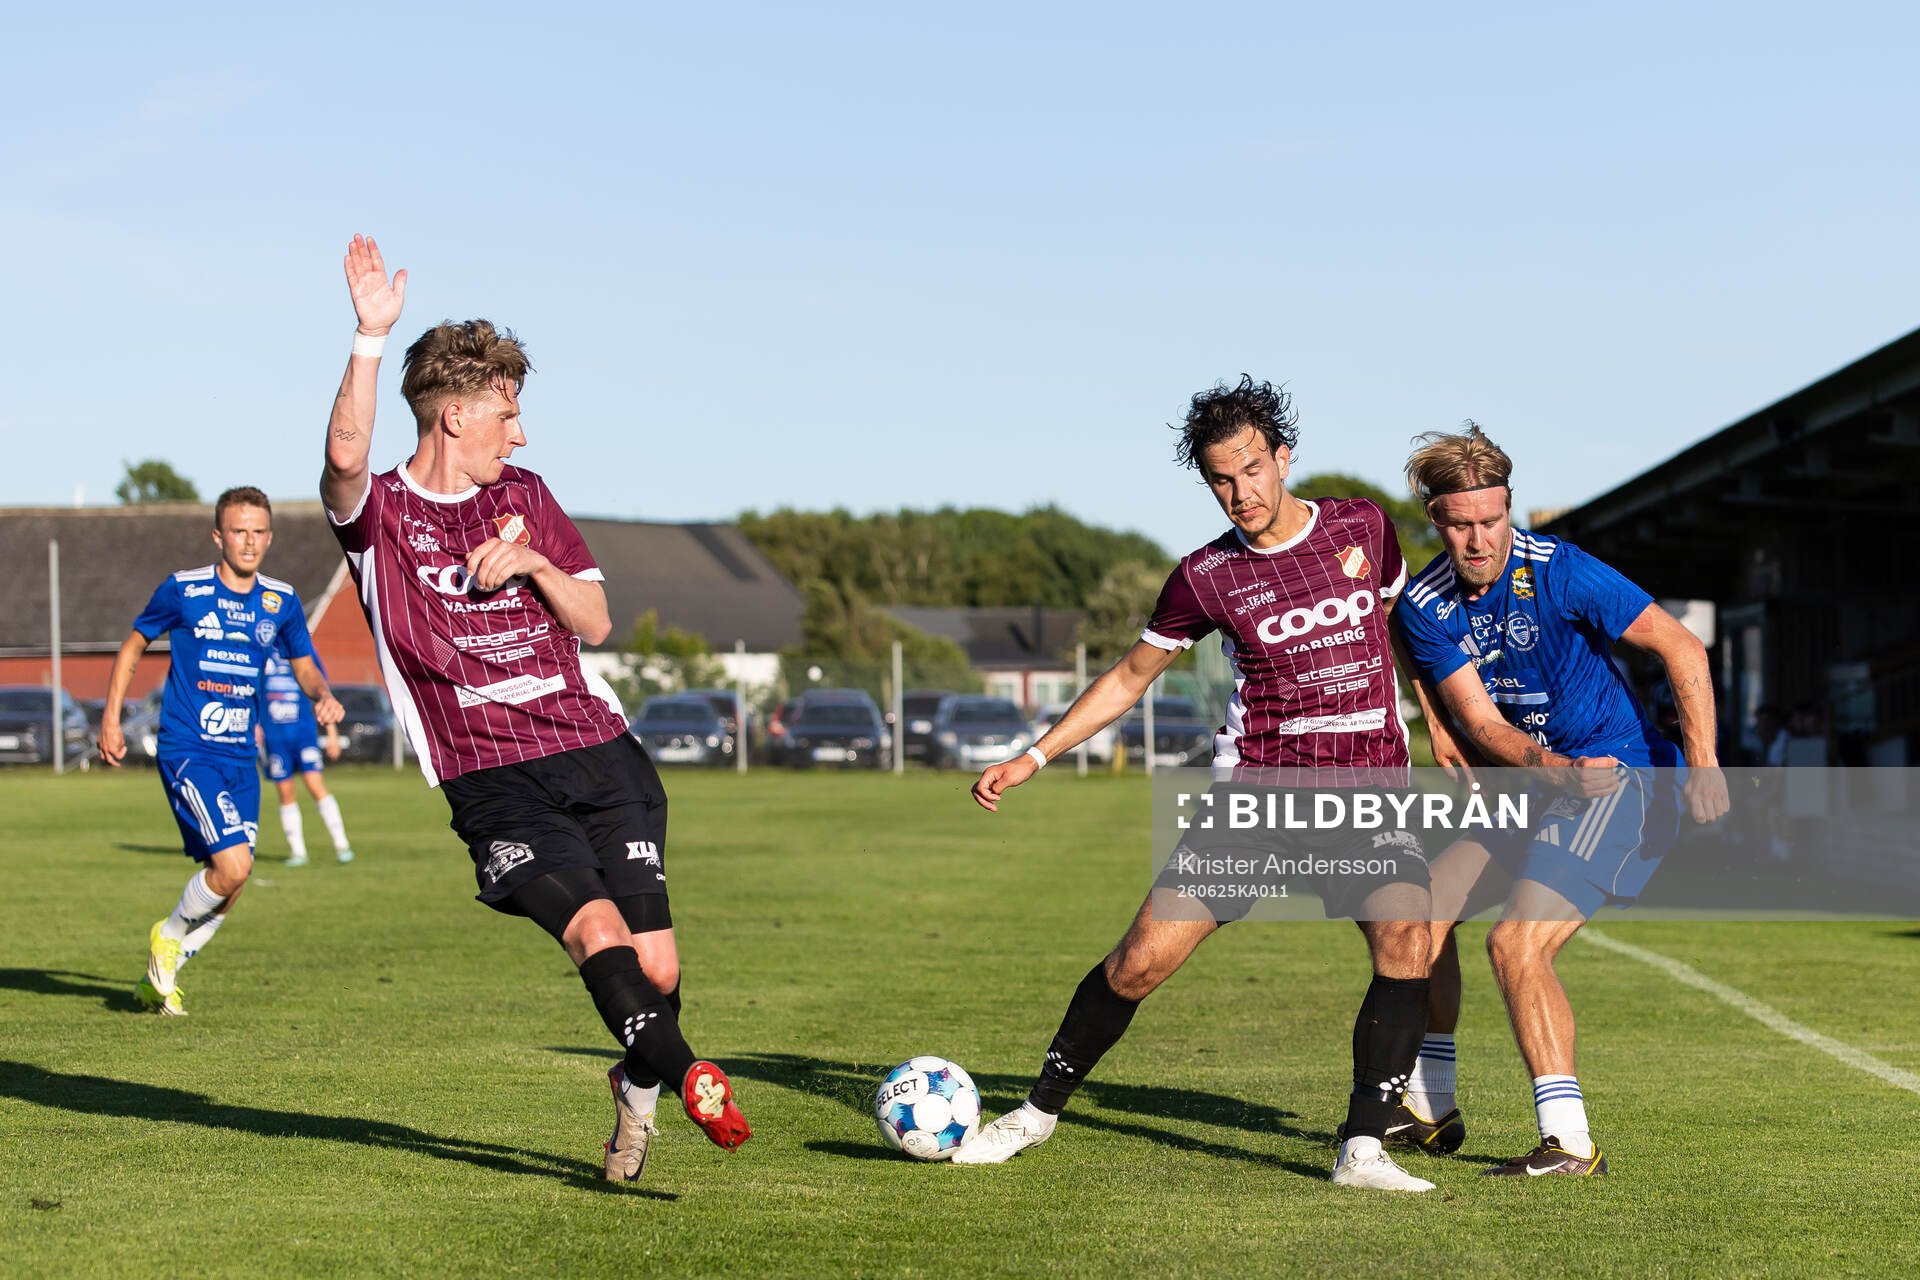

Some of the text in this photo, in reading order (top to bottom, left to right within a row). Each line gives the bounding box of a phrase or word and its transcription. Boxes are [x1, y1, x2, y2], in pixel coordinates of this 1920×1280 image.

[417, 564, 529, 596] co
[1228, 583, 1260, 597] CRAFT
[1246, 590, 1276, 606] TEAM
[1257, 589, 1376, 645] coop
[452, 621, 550, 652] stegerud
[1285, 627, 1366, 655] VARBERG
[480, 645, 536, 664] steel
[1297, 655, 1383, 683] stegerud
[1324, 678, 1370, 696] steel
[877, 1079, 918, 1111] SELECT
